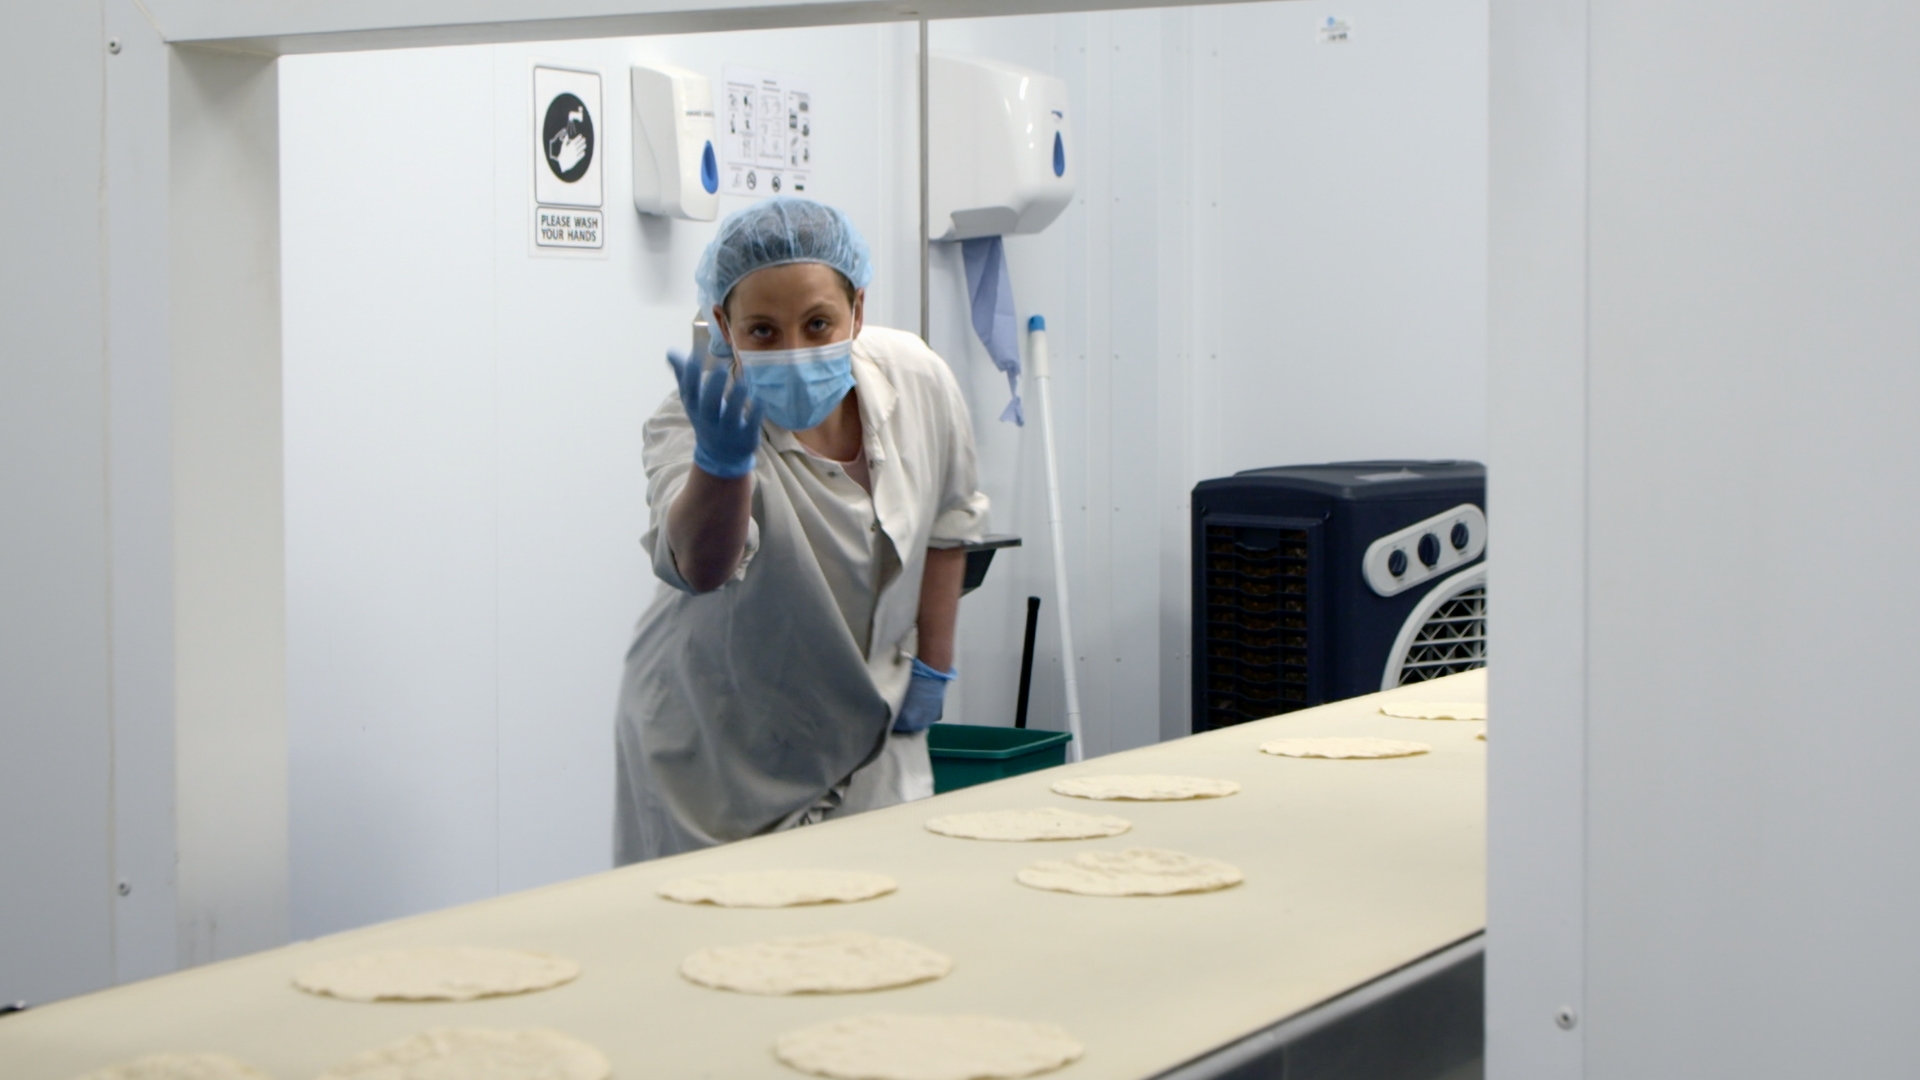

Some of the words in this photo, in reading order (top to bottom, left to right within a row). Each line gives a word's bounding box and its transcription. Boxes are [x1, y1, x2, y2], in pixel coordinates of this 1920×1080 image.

[541, 214, 571, 227] PLEASE
[574, 216, 598, 228] WASH
[541, 228, 564, 240] YOUR
[567, 229, 596, 242] HANDS
